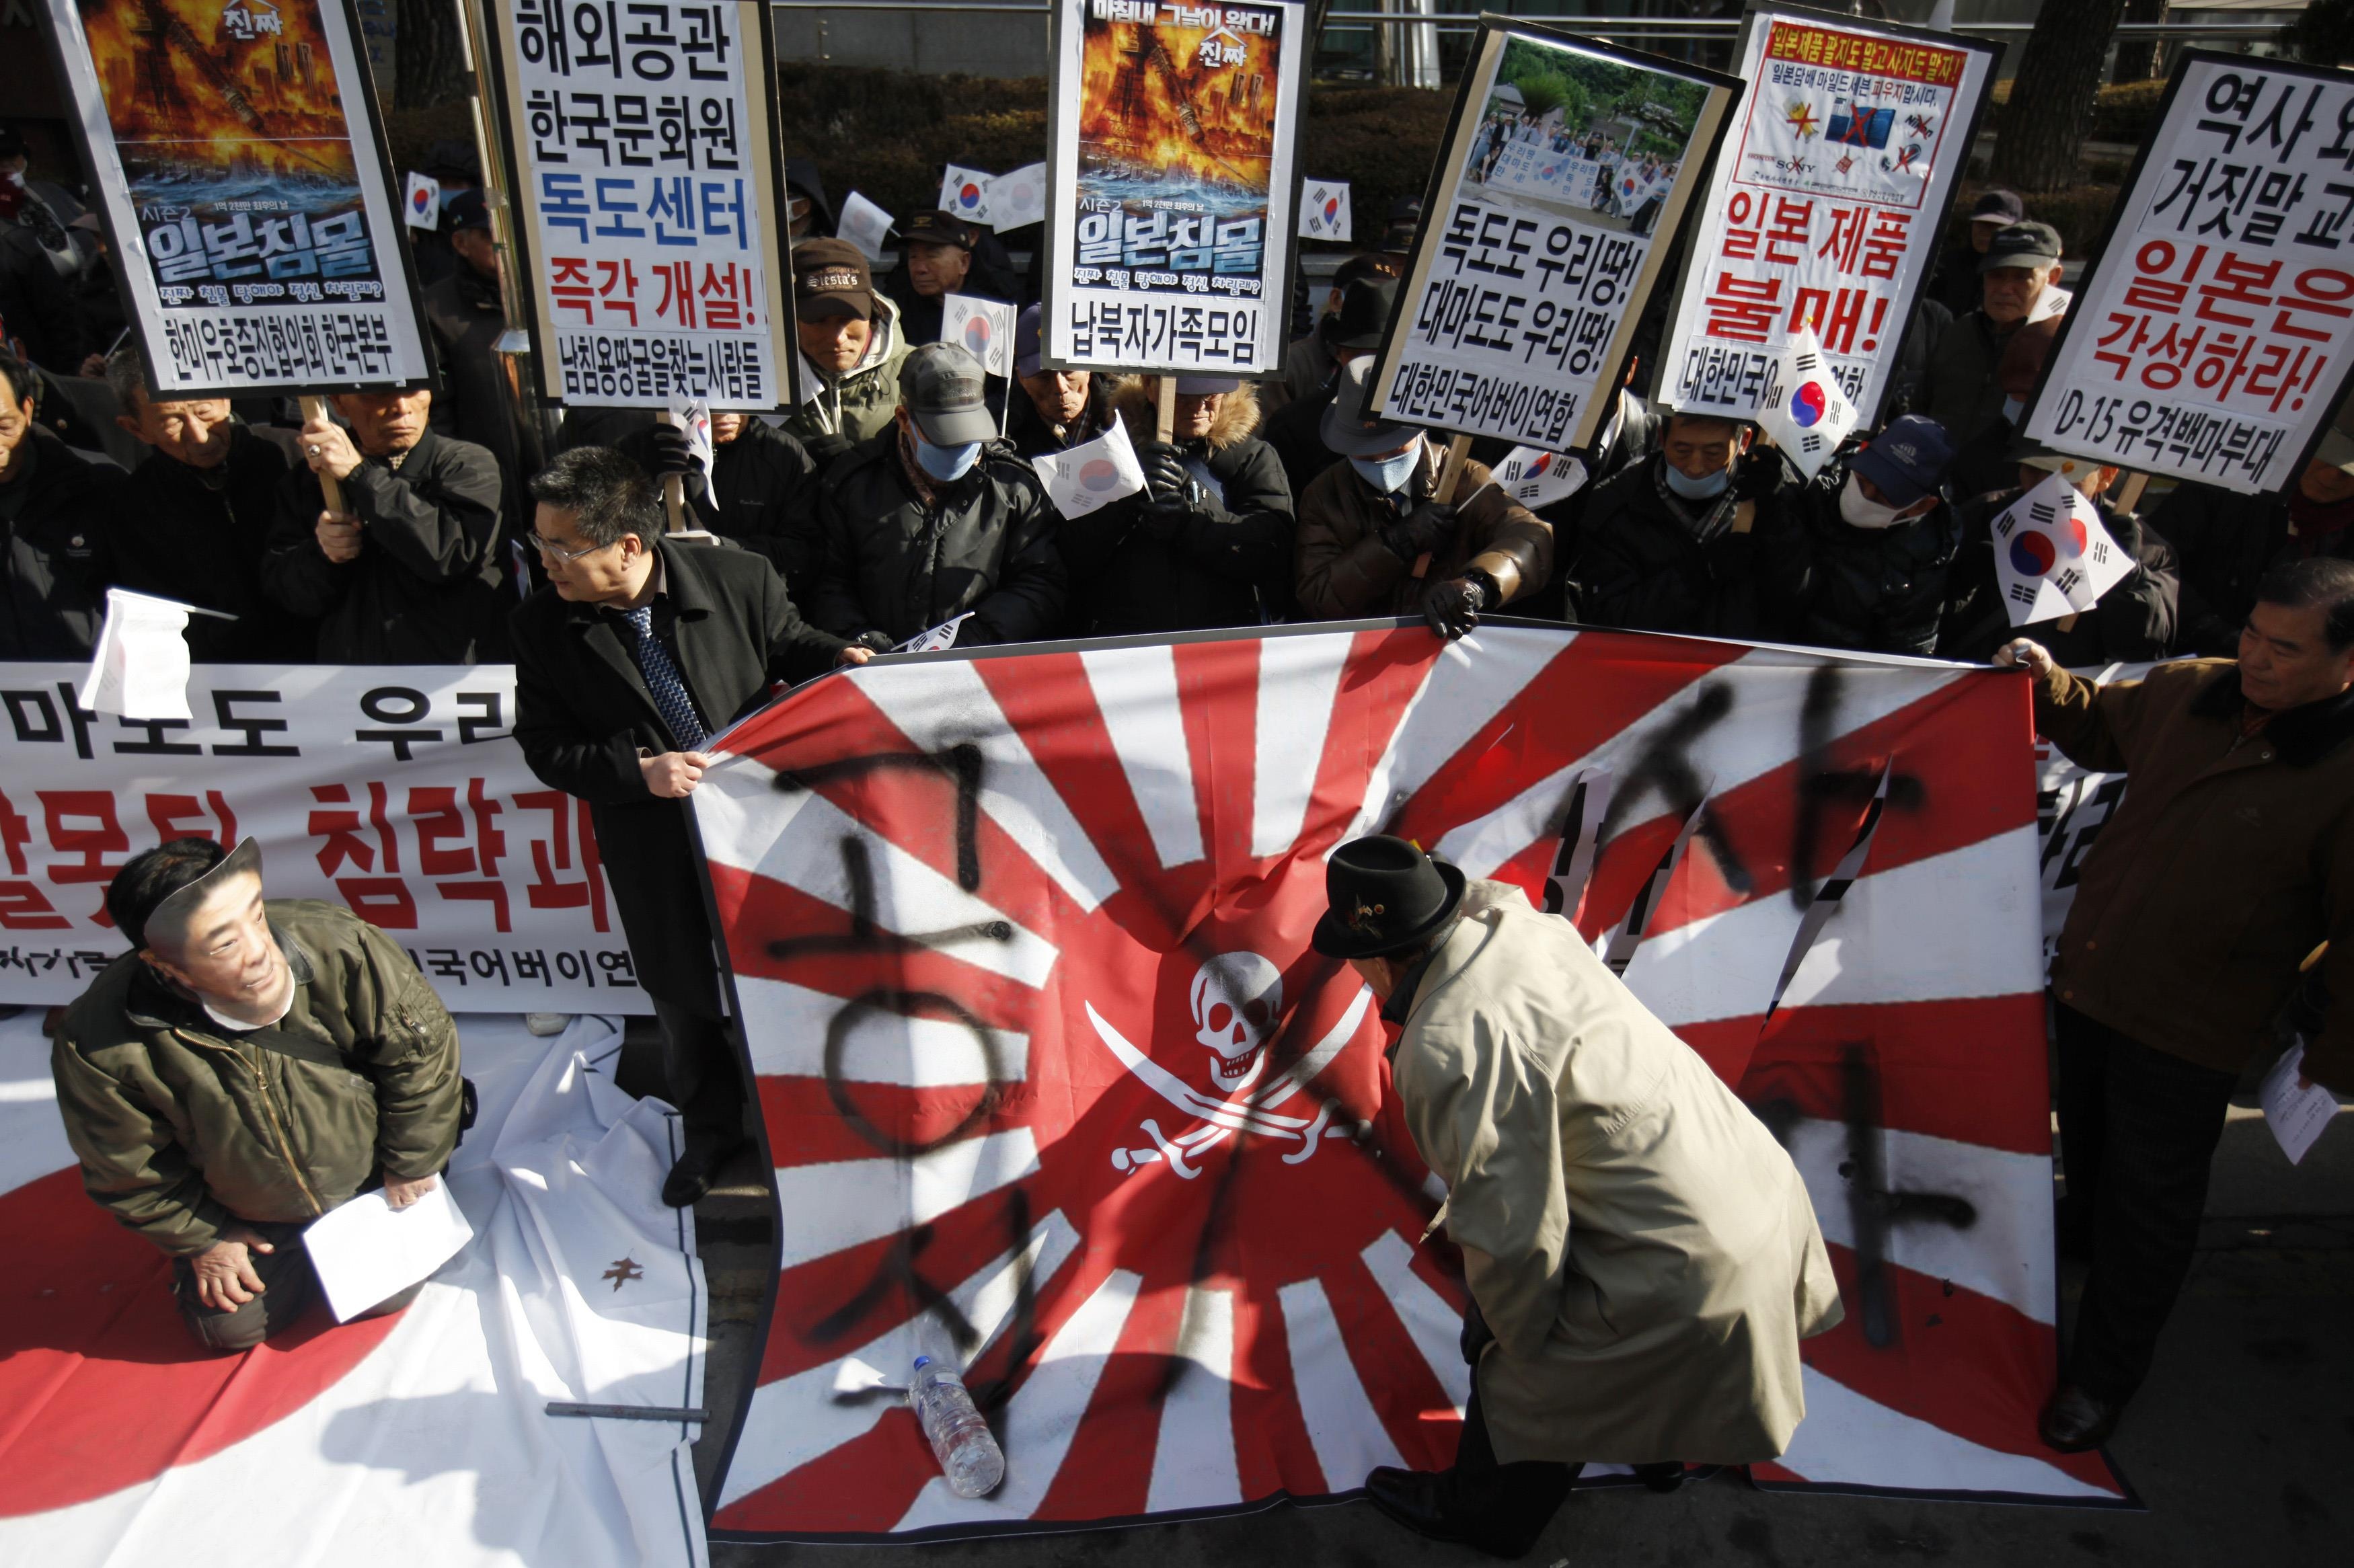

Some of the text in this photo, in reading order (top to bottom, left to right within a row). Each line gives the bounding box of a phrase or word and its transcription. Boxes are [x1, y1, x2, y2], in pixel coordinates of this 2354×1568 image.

[223, 7, 283, 39] 진짜
[516, 1, 732, 82] 해외공관
[1093, 0, 1275, 36] 마침내 그날이 왔다!
[1199, 40, 1248, 68] 진짜
[527, 89, 740, 171] 한국문화원
[2196, 73, 2325, 163] 역사
[1776, 159, 1816, 173] SONY
[141, 206, 191, 222] 시즌2
[540, 172, 749, 251] 독도센터
[1079, 198, 1122, 213] 시즌2
[1721, 190, 1912, 281] 일본 제품
[2153, 157, 2354, 250] 거짓말 교
[149, 210, 371, 282] 일본침몰
[1078, 210, 1263, 273] 일본침몰
[1444, 203, 1642, 307] 독도도 우리땅!
[159, 280, 383, 307] 진짜 침몰 당해야 정신 차릴래?
[550, 257, 757, 330] 즉각 개설!
[1074, 268, 1261, 296] 진짜 침몰 당해야 정신 차릴래?
[2123, 239, 2354, 342] 일본은
[165, 313, 393, 381] 한미우호증진협의회 한국본부
[1070, 300, 1256, 365] 납북자가족모임
[1417, 278, 1616, 377] 대마도도 우리땅!
[2094, 311, 2327, 413] 각성하라!
[1389, 361, 1578, 444] 대한민국어버이연합
